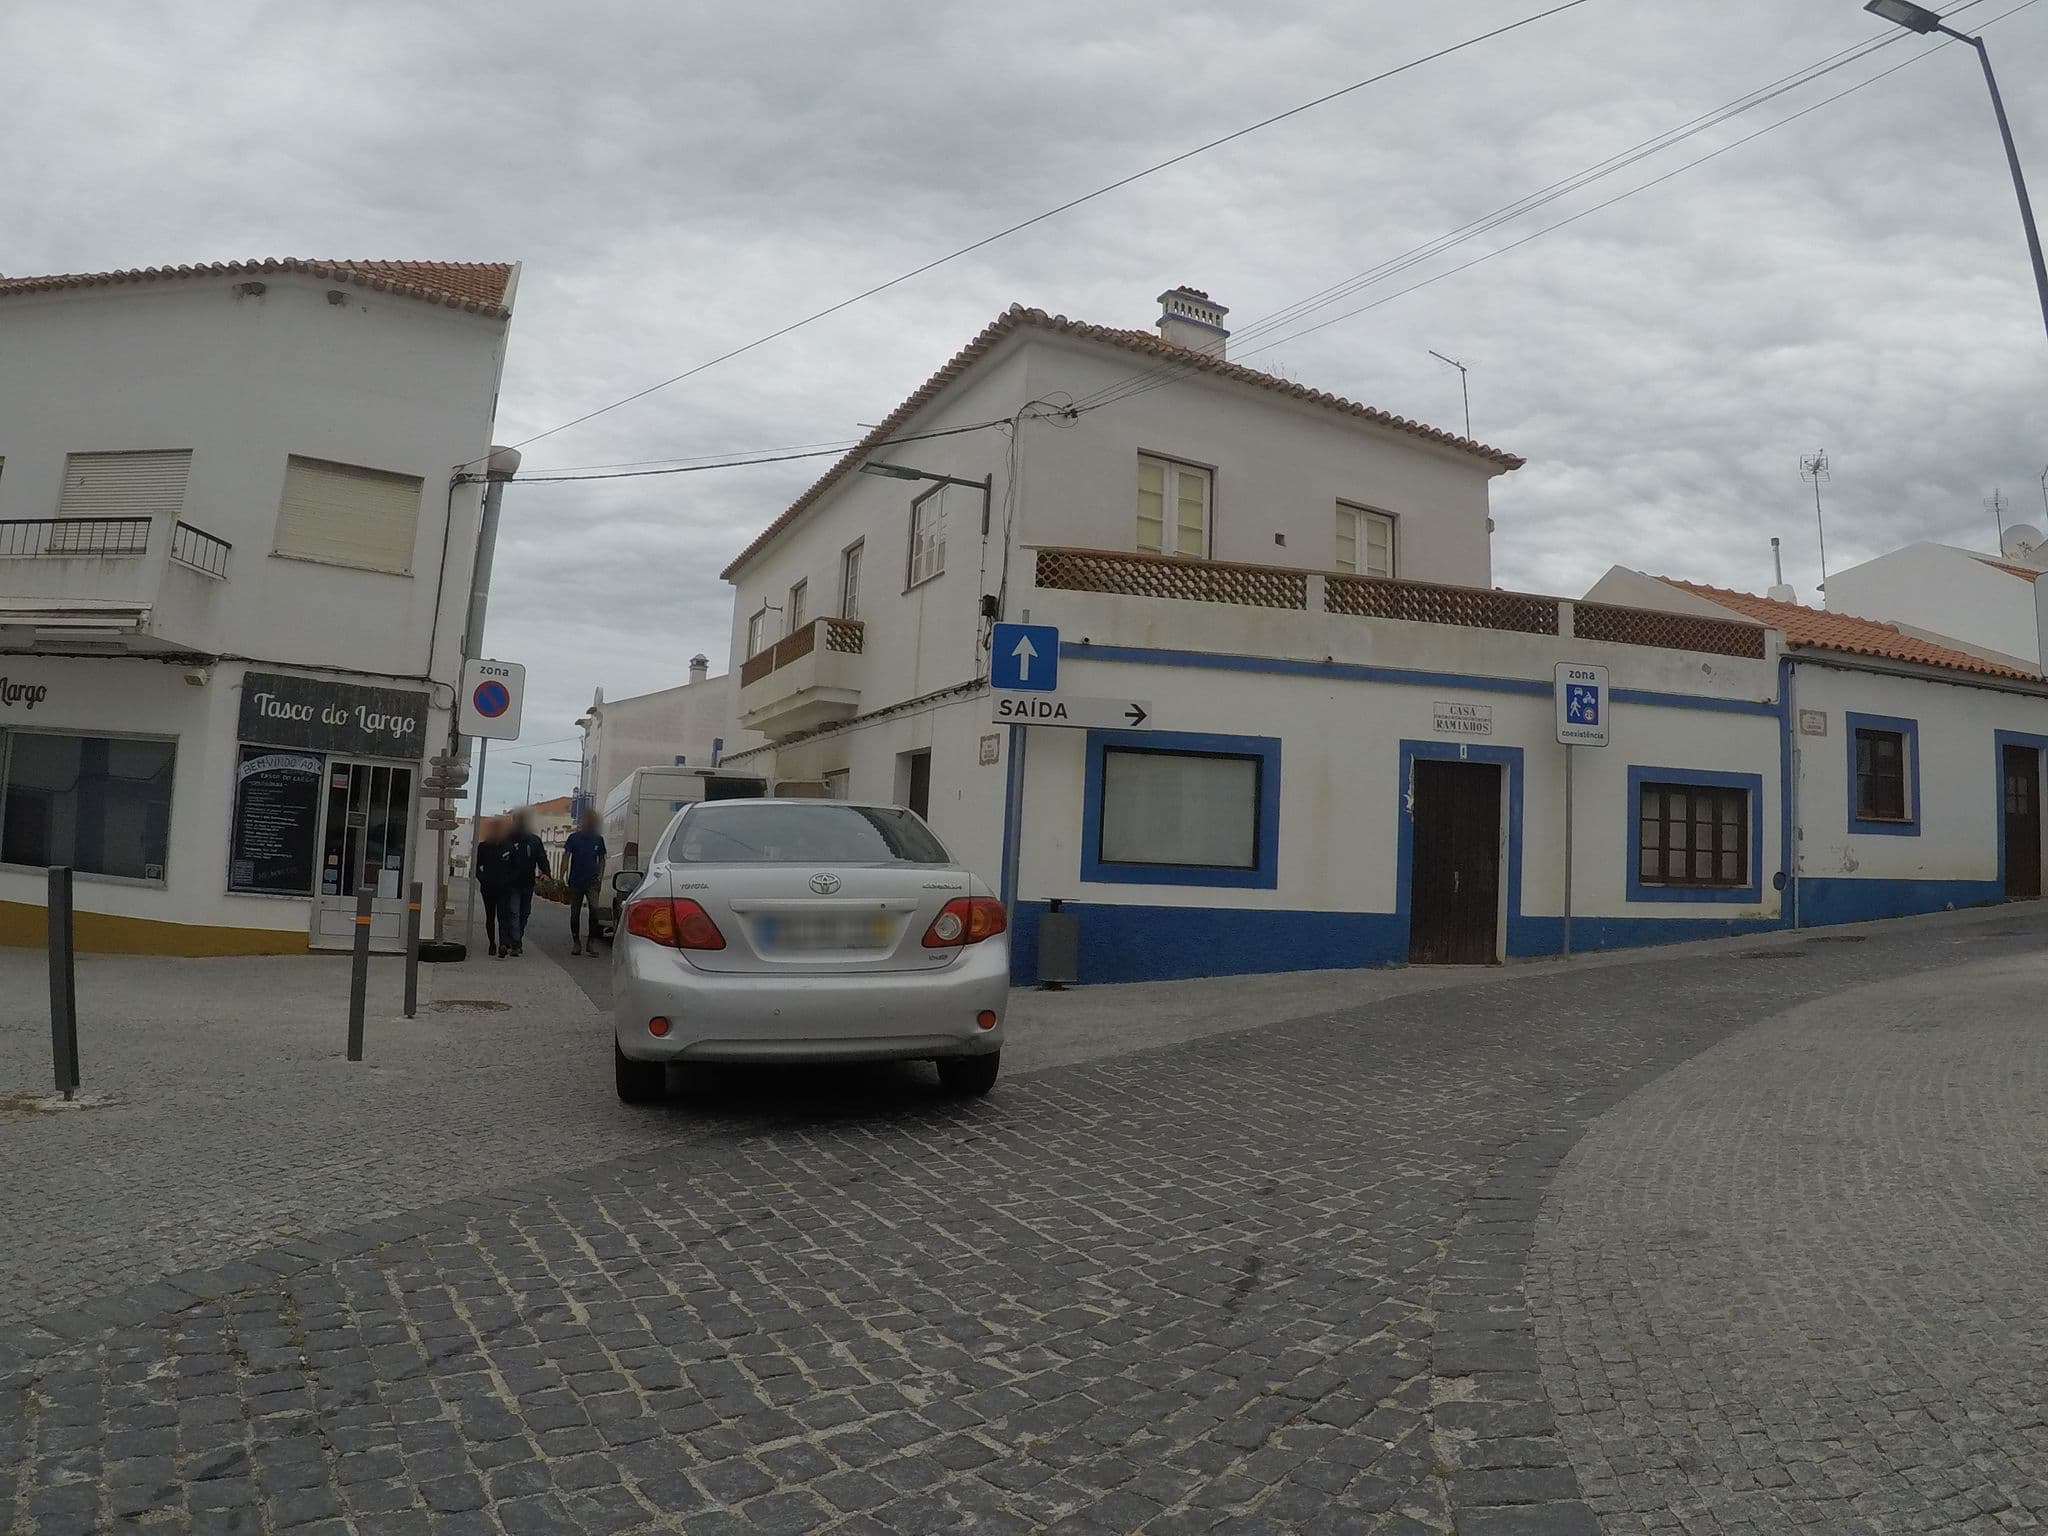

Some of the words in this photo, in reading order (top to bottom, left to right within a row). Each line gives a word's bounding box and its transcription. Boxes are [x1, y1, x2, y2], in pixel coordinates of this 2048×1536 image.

[480, 666, 509, 677] zona
[1569, 670, 1596, 680] zona
[998, 697, 1068, 719] SAÍDA
[1450, 705, 1476, 716] CASA
[254, 692, 314, 721] Tasco
[321, 703, 349, 726] do
[355, 705, 416, 739] Largo
[1436, 719, 1489, 732] RAMINHOS
[1562, 730, 1604, 740] coexistência
